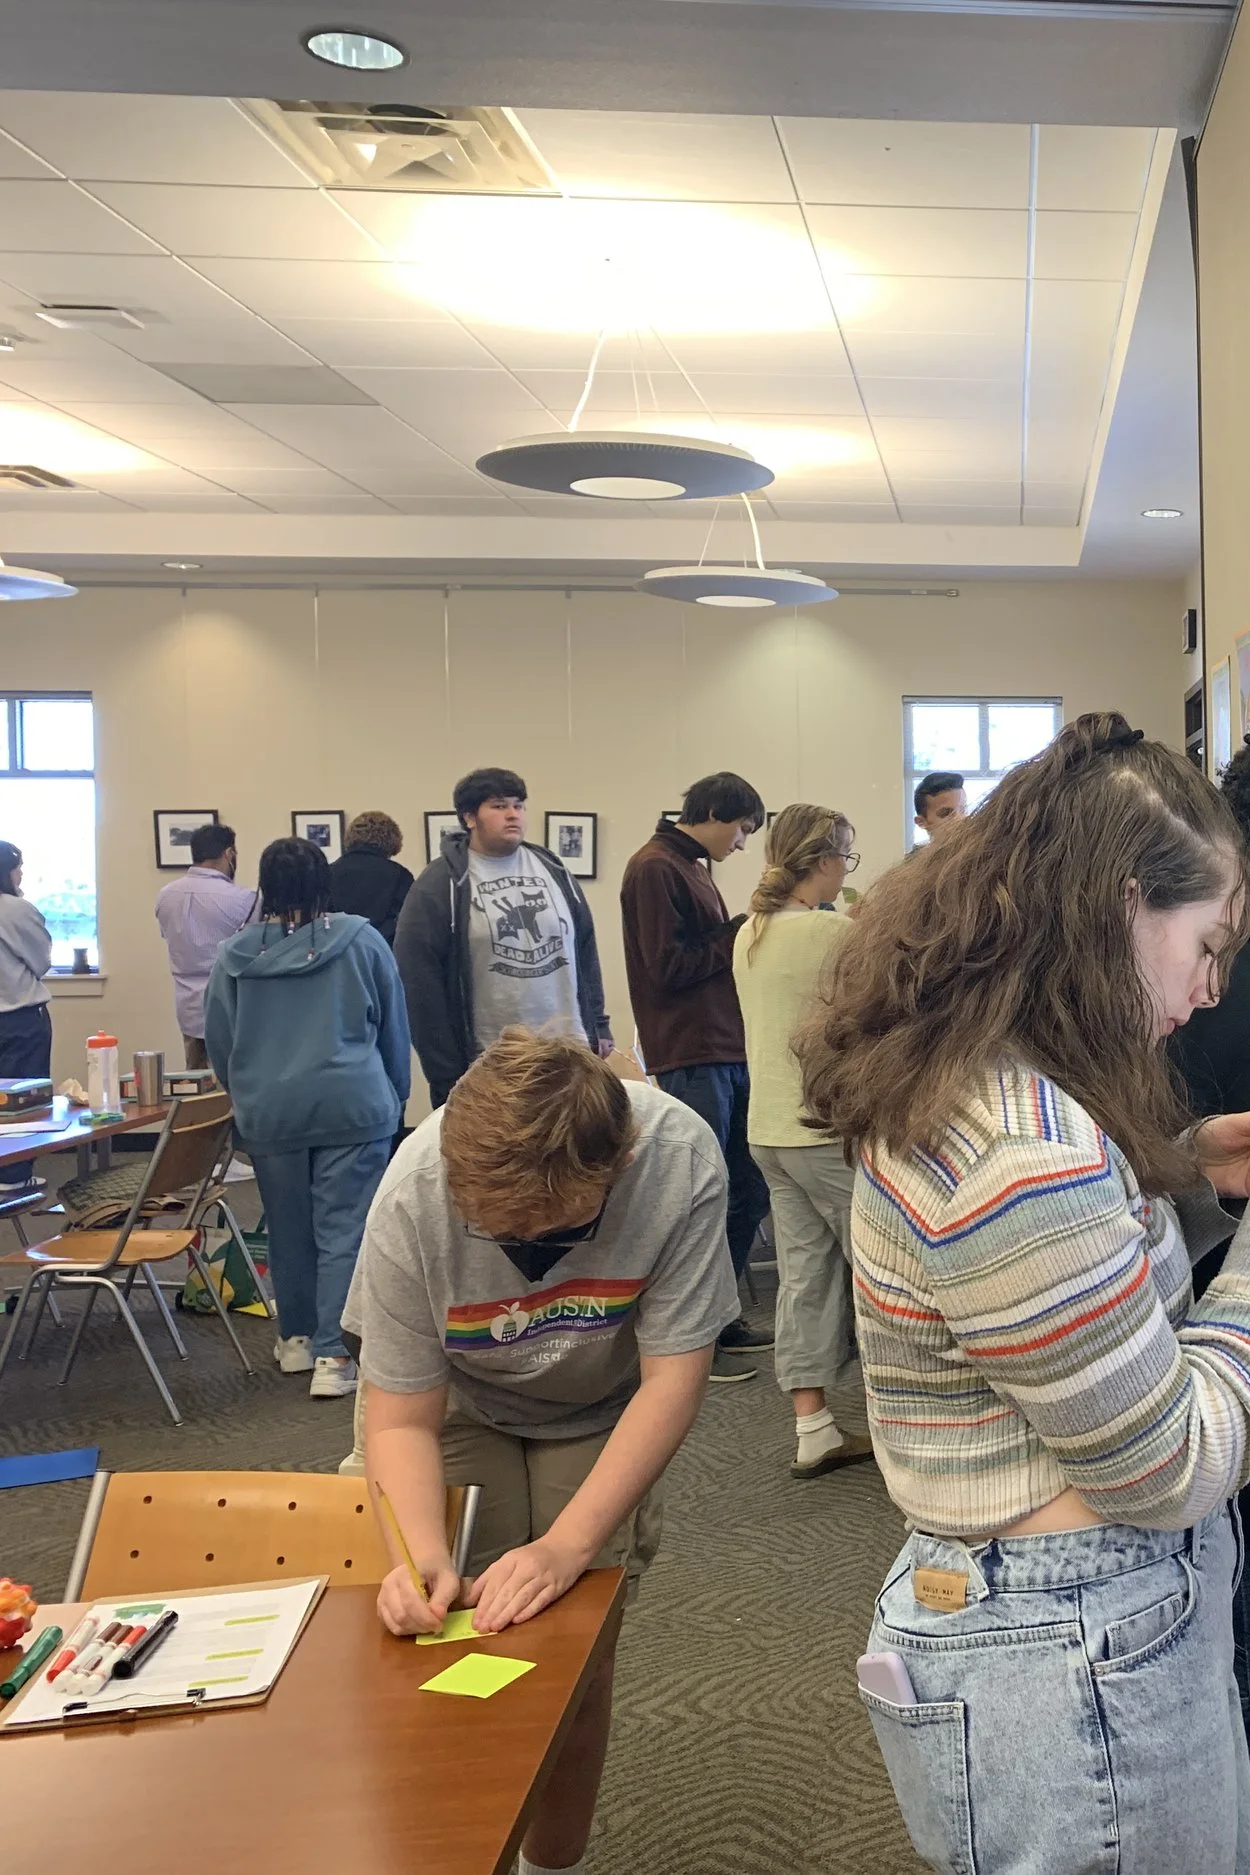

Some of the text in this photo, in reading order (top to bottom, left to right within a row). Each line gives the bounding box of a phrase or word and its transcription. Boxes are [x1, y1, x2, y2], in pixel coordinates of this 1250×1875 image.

[478, 877, 546, 893] WANTED
[494, 944, 525, 962] DEAD
[534, 940, 562, 963] ALIVE
